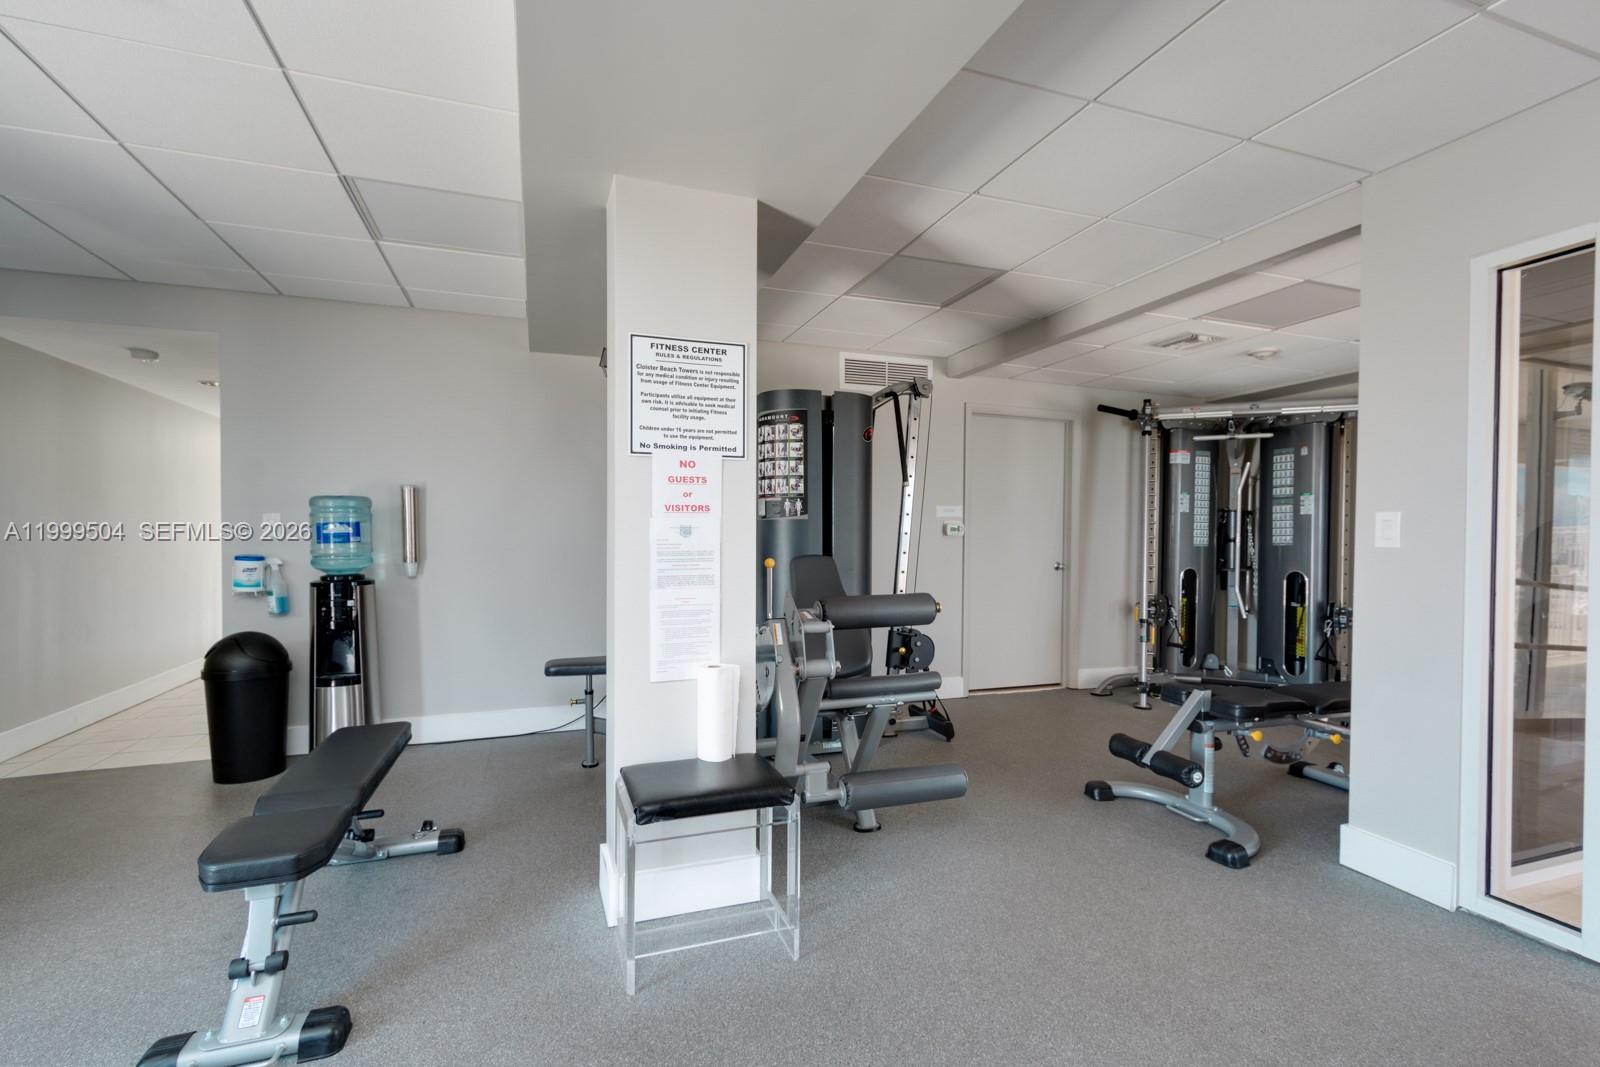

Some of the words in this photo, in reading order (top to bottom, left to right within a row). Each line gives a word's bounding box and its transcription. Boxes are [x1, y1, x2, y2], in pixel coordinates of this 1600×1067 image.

[650, 342, 688, 352] FITNESS
[692, 346, 727, 356] CENTER
[653, 443, 688, 451] Smoking
[680, 460, 696, 468] NO
[668, 475, 708, 484] GUESTS
